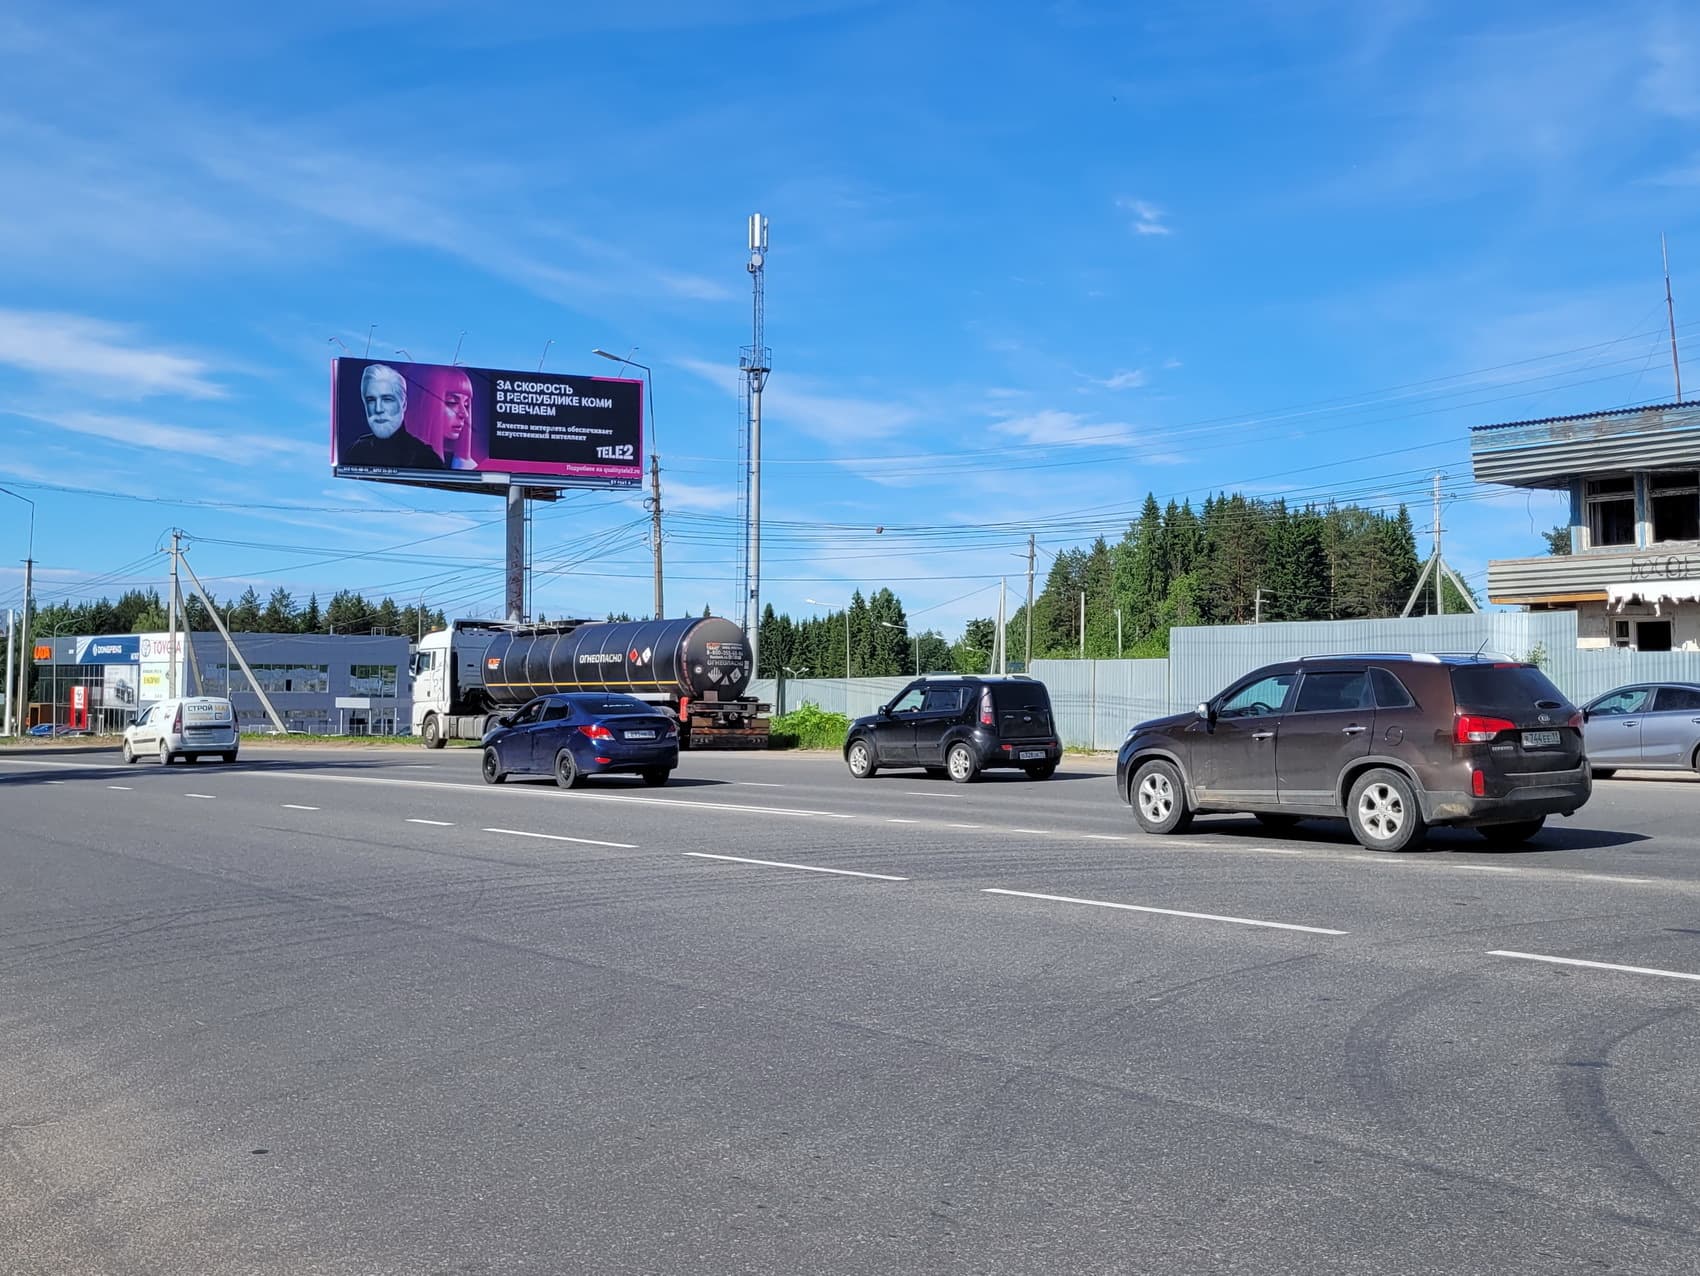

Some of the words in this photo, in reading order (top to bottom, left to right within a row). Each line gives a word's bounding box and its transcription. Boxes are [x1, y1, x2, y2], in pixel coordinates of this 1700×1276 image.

[496, 380, 512, 391] ЗА
[514, 381, 574, 395] СКОРОСТЬ
[496, 391, 505, 401] В
[506, 392, 580, 407] РЕСПУБЛИКЕ
[581, 397, 613, 409] КОМИ
[496, 403, 557, 416] ОТВЕЧАЕМ
[596, 444, 634, 460] TELE2
[153, 639, 182, 655] TOYOA
[579, 653, 623, 664] ОГНЕОПАСНО
[187, 704, 214, 712] СТРОЙ
